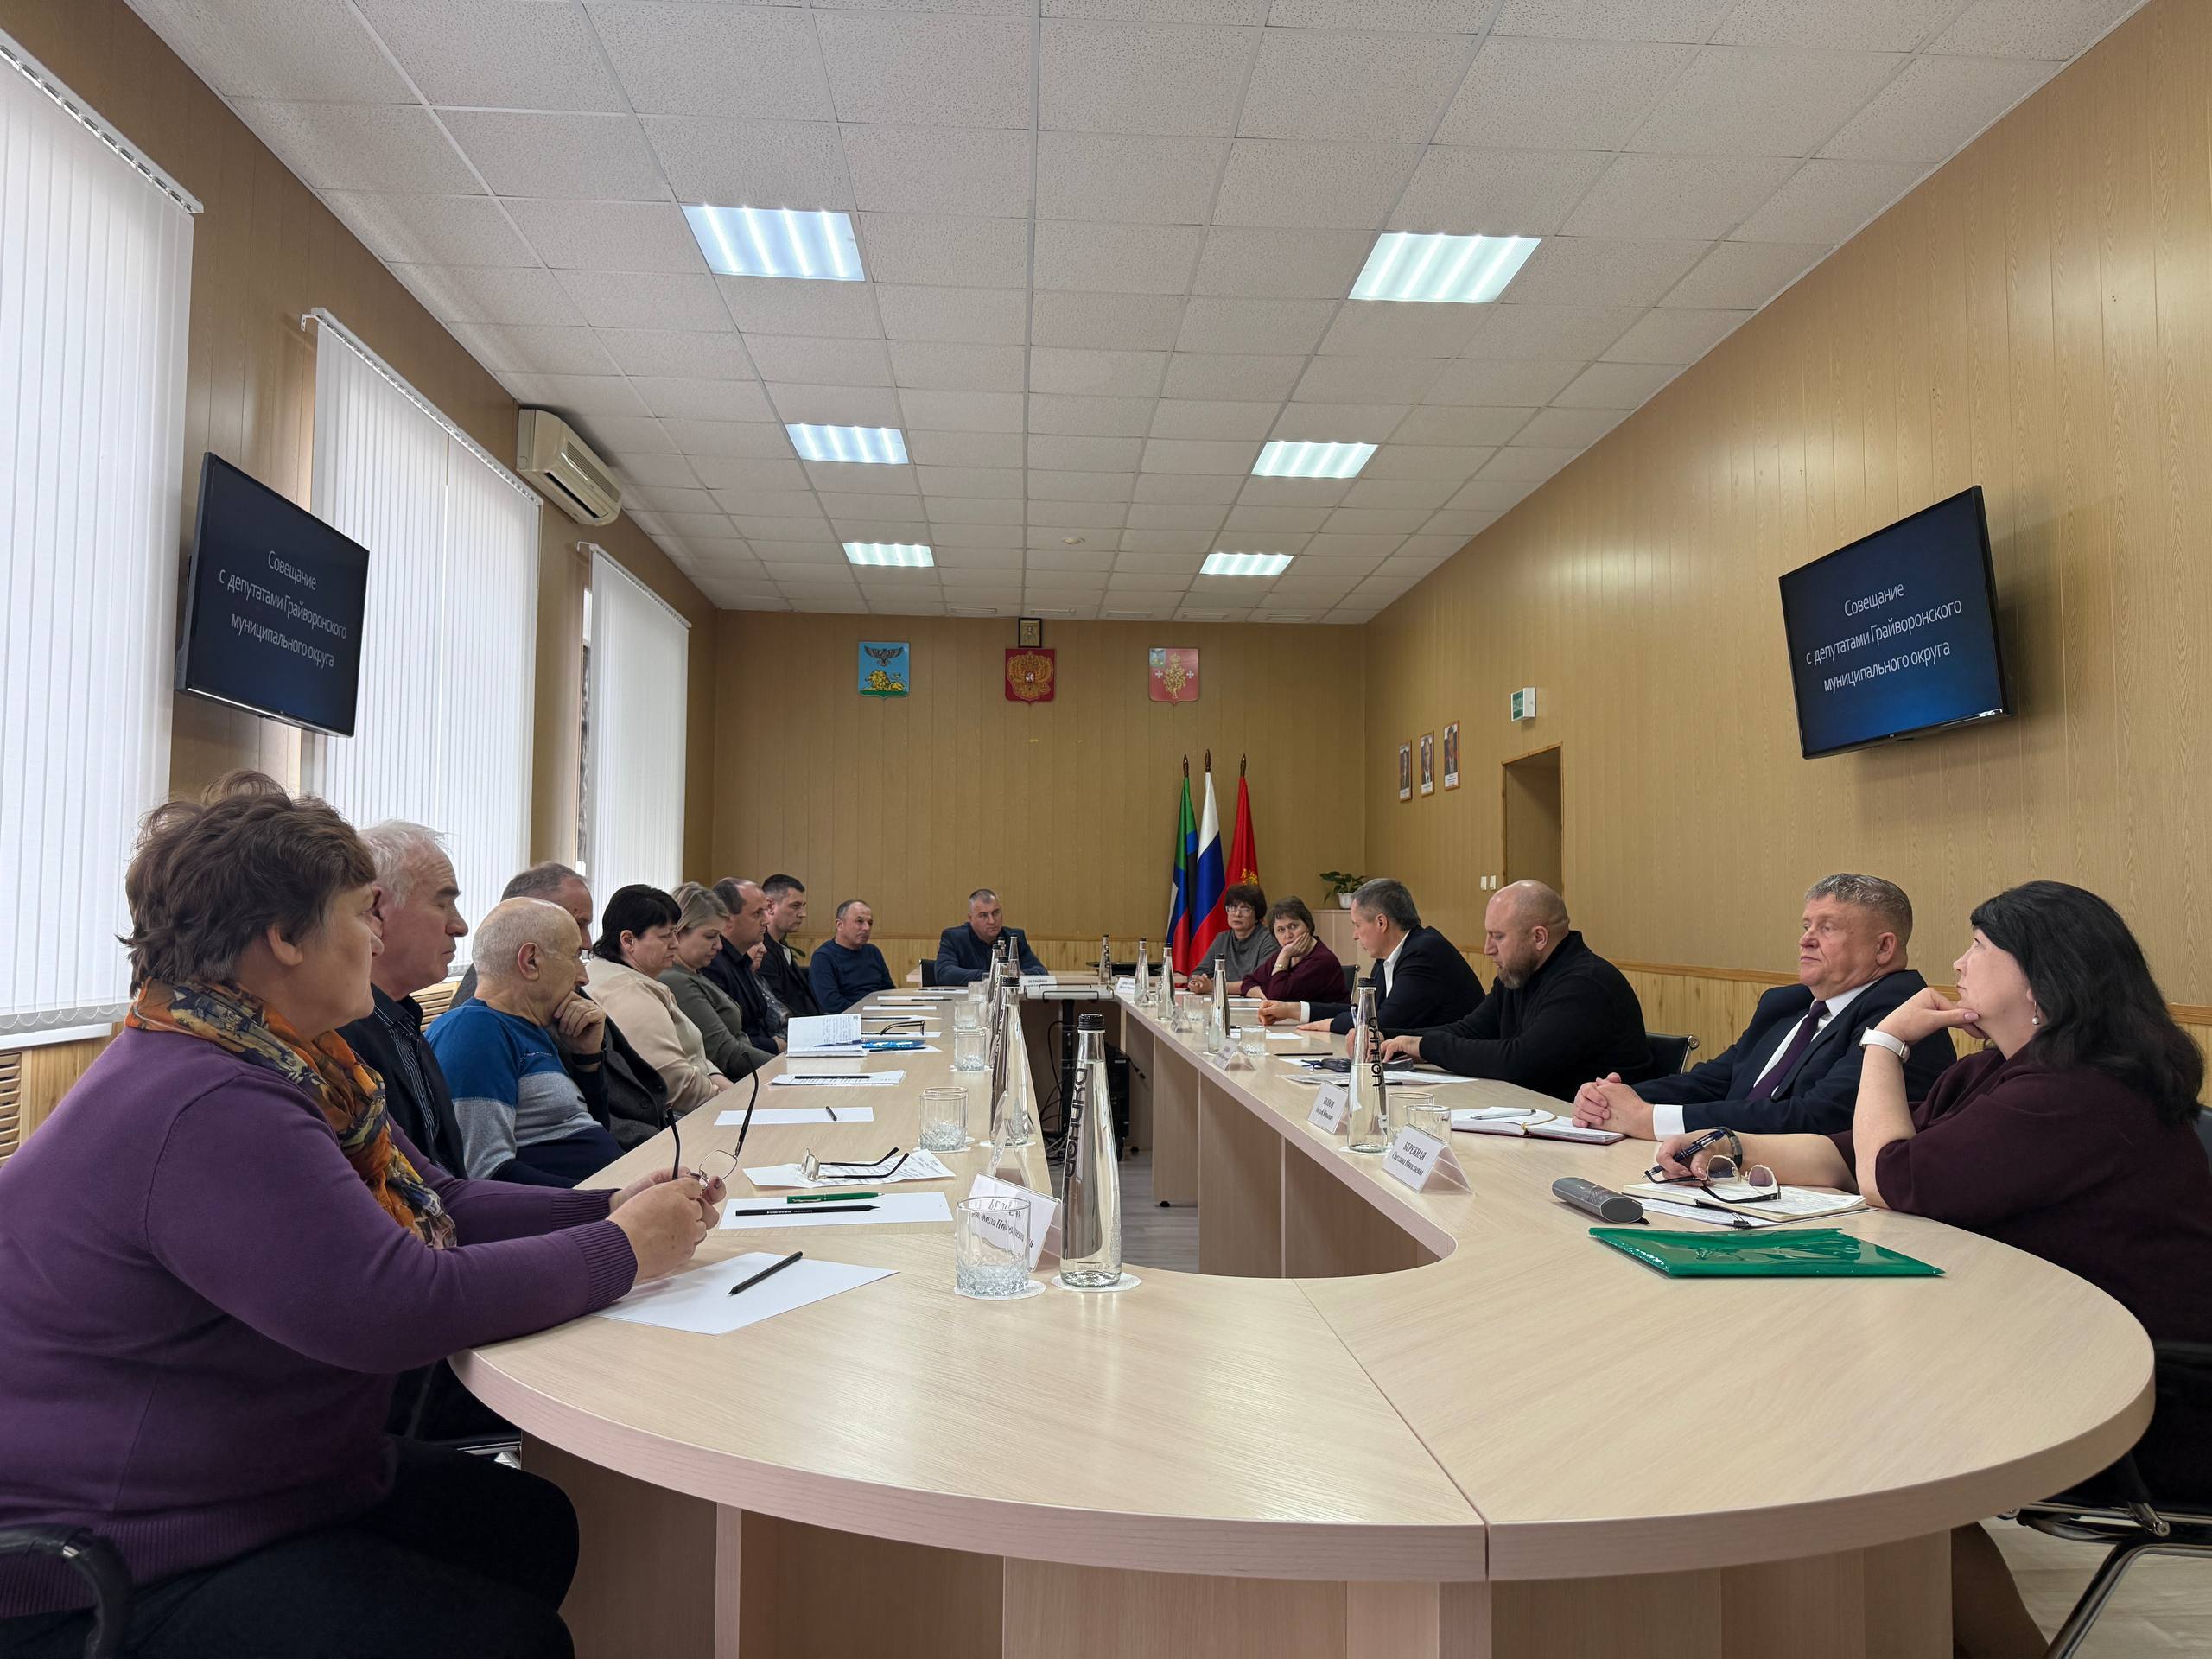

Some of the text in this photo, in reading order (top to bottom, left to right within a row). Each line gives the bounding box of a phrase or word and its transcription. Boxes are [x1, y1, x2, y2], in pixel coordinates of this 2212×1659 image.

[268, 550, 317, 590] Совещание
[227, 573, 283, 610] депутатами
[283, 594, 346, 639] Грайворонского
[1844, 583, 1904, 617] Совещание
[231, 613, 334, 669] муниципального округа
[1815, 629, 1870, 666] депутатами
[1870, 600, 1962, 646] Грайворонского
[1824, 640, 1950, 694] муниципального округа
